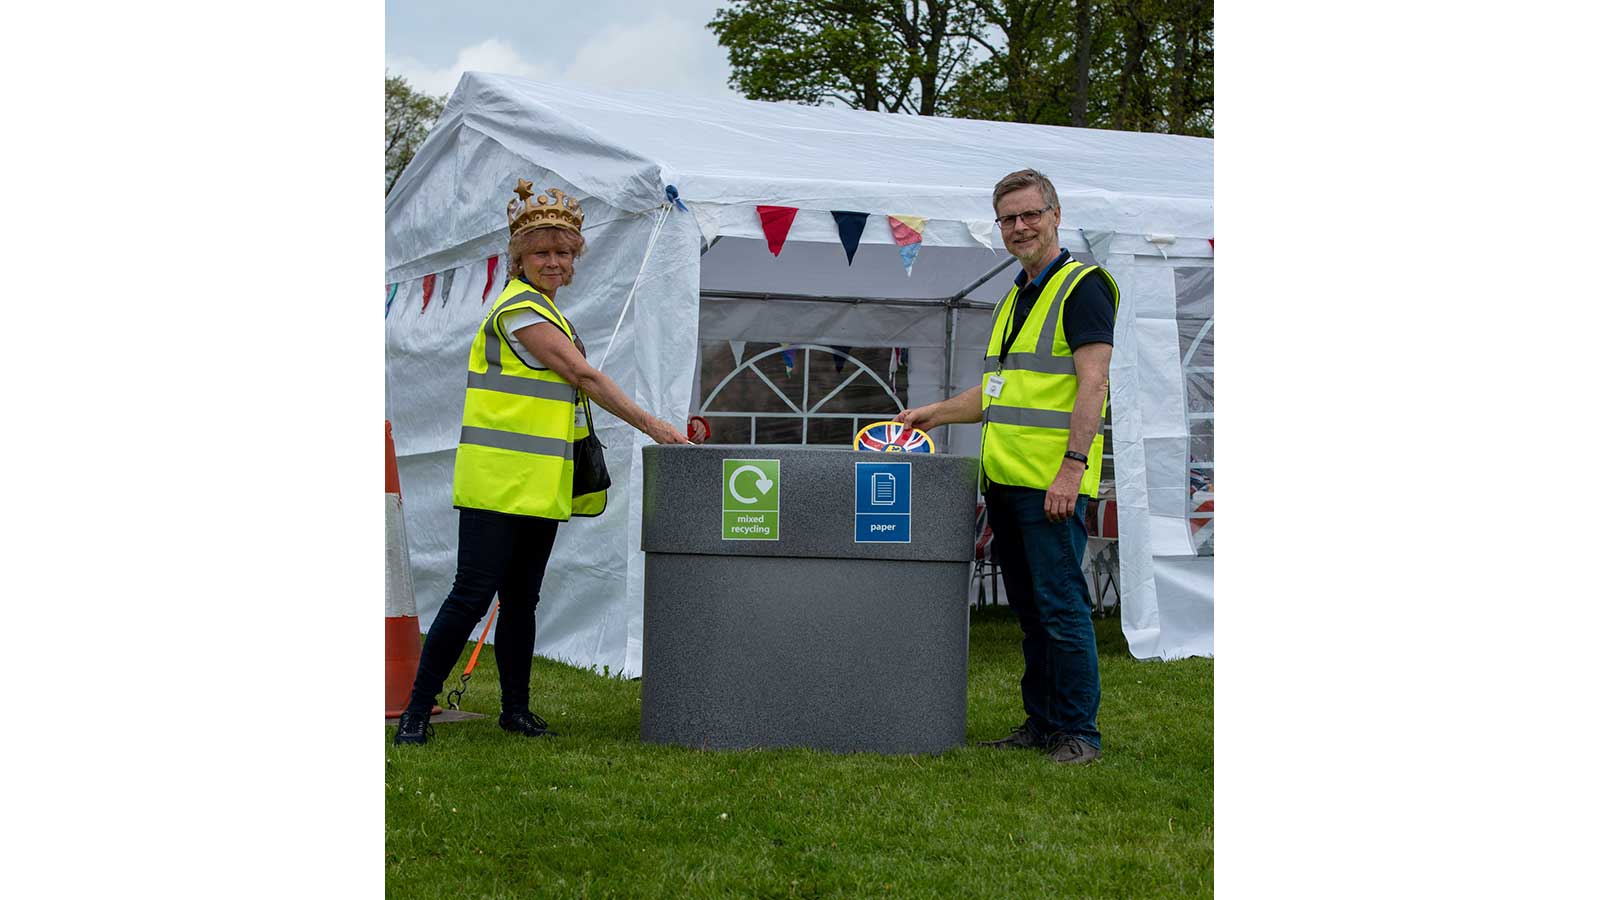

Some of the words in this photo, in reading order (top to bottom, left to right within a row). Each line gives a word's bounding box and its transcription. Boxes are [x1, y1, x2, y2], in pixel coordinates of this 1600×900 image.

[737, 514, 765, 523] mixed
[731, 525, 770, 535] recycling
[870, 524, 897, 533] paper
